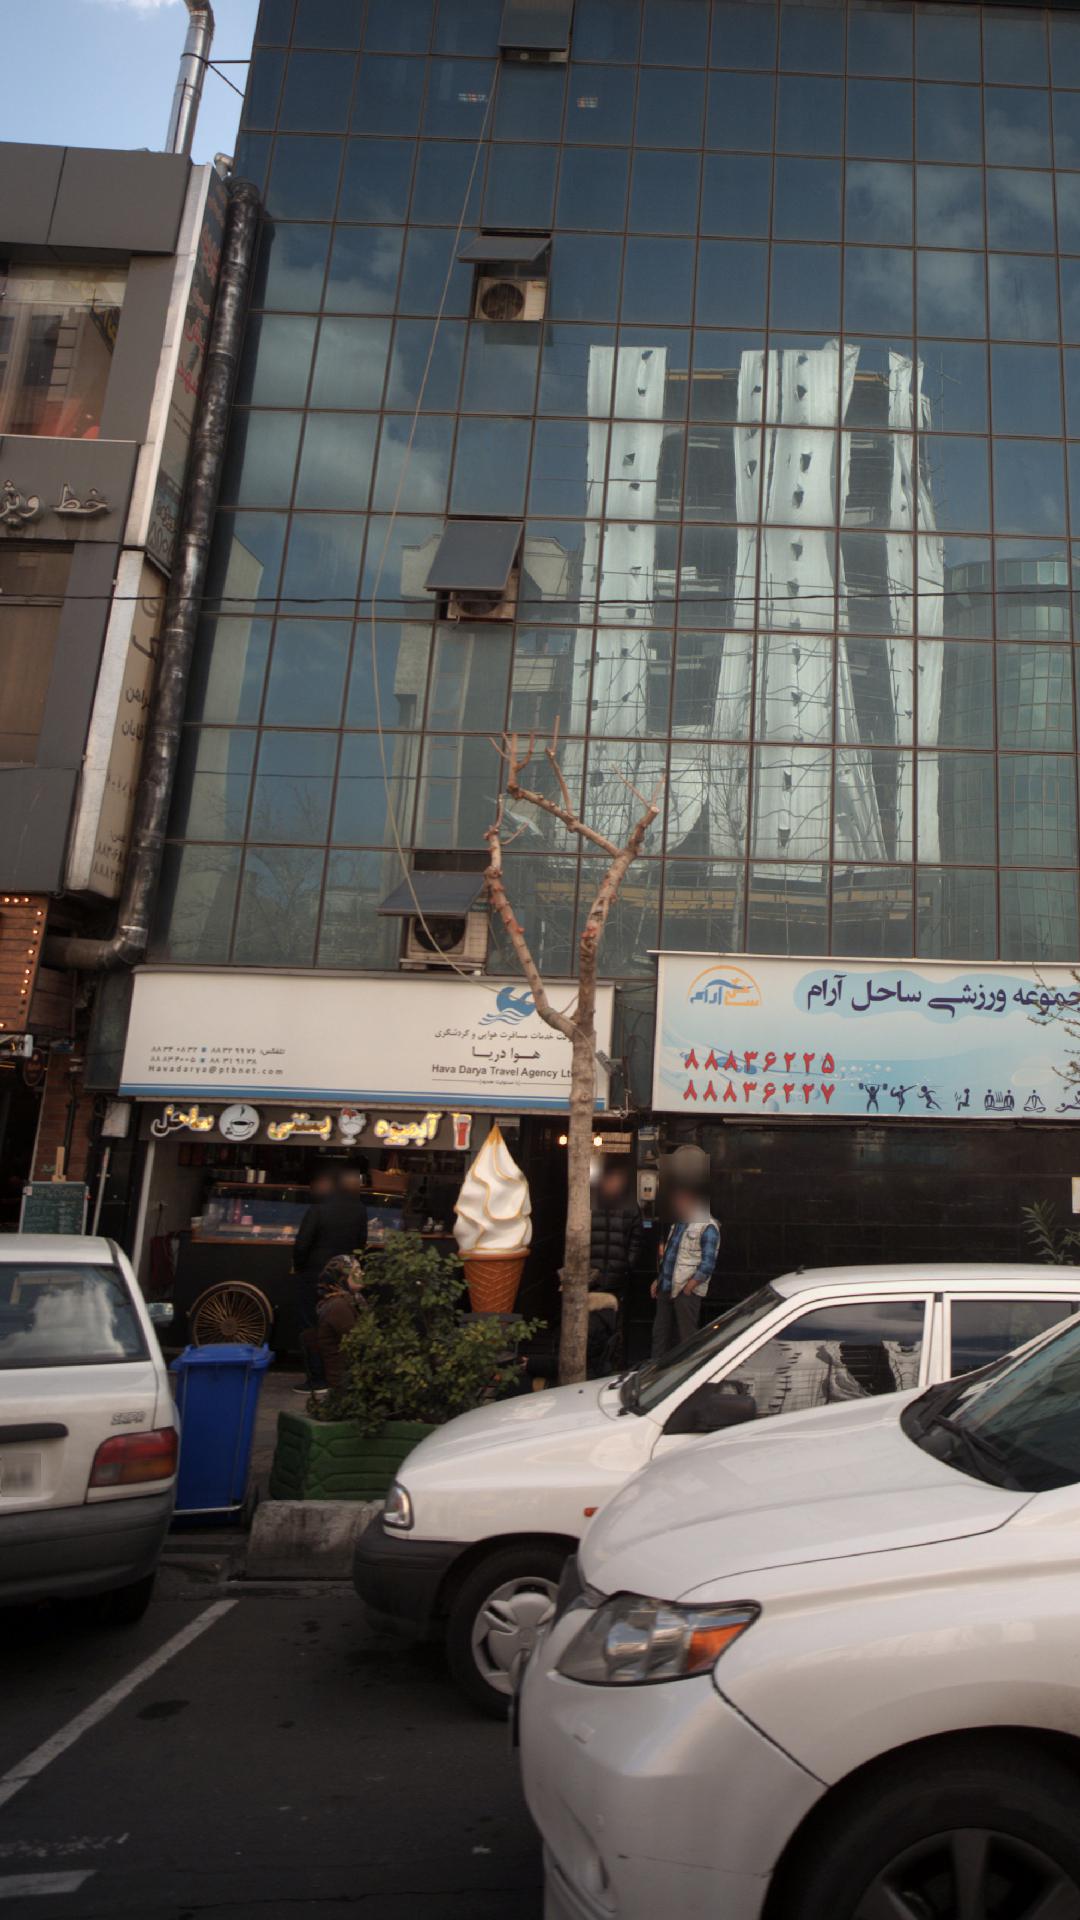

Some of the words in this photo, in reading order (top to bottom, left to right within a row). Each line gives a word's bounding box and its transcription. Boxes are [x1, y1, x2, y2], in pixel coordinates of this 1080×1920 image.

[807, 974, 847, 1010] آرام
[851, 979, 922, 1012] ساحل
[927, 983, 1007, 1018] ورزشی
[471, 1046, 507, 1062] دریا
[510, 1047, 541, 1063] هوا
[684, 1048, 835, 1074] ۸۸۸۳۶۲۲۵
[432, 1064, 456, 1074] Hava
[458, 1065, 487, 1077] Darya
[490, 1066, 519, 1077] Travel
[521, 1067, 558, 1079] Agency
[683, 1079, 835, 1105] ۸۸۸۳۶۲۲۷
